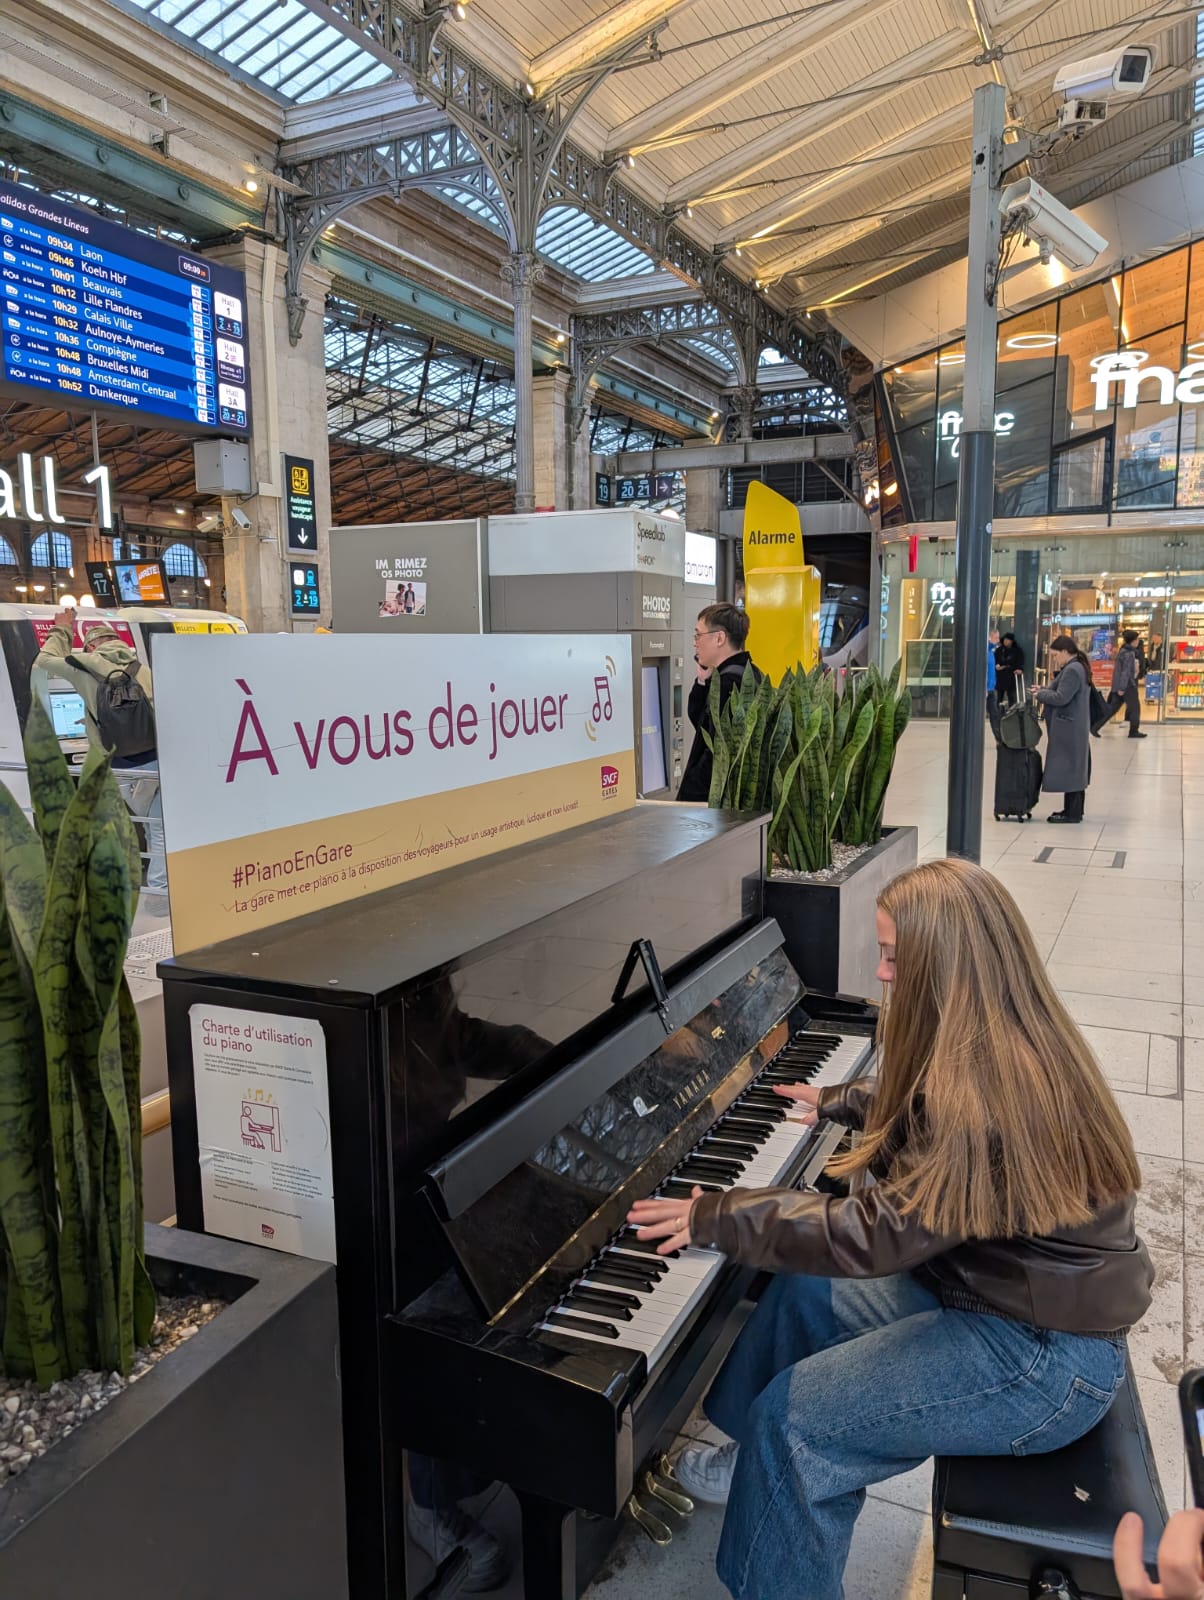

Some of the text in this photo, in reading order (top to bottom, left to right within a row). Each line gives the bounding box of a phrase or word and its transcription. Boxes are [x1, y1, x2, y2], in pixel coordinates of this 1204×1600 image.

[28, 204, 62, 224] Grandes
[47, 235, 74, 252] 09h34
[80, 245, 104, 263] Laon
[48, 251, 75, 268] 09h46
[81, 261, 108, 280] Koeln
[110, 271, 128, 286] Hbf
[50, 267, 75, 283] 10h01
[82, 276, 122, 299] Beauvais
[51, 283, 77, 300] 10h12
[83, 292, 103, 308] Lille
[105, 298, 143, 320] Flandres
[52, 300, 78, 315] 10h29
[84, 307, 112, 325] Calais
[113, 316, 133, 331] Ville
[53, 315, 79, 331] 10h32
[85, 323, 165, 355] Aulnoye-Aymeries
[54, 331, 80, 346] 10h36
[86, 338, 137, 362] Compiègne
[224, 343, 237, 353] Hall
[55, 347, 81, 362] 10h48
[87, 353, 129, 374] Bruxelles
[130, 365, 149, 379] Midi
[225, 352, 229, 360] 2
[56, 363, 82, 377] 10h48
[88, 369, 140, 391] Amsterdam
[141, 382, 177, 400] Centraal
[57, 379, 83, 392] 10h52
[89, 384, 139, 405] Dunkerque
[228, 397, 238, 407] 3A
[84, 465, 112, 529] 1
[599, 484, 609, 499] 19
[621, 485, 650, 497] 20 21
[749, 530, 796, 545] Alarme
[93, 580, 108, 594] 17
[394, 569, 423, 578] PHOTO
[309, 595, 319, 606] 19
[643, 595, 671, 612] PHOTOS
[225, 678, 569, 784] À vous de jouer
[602, 772, 618, 787] SNCF
[232, 844, 353, 889] #PianoEnGare
[235, 900, 248, 913] La
[251, 892, 275, 912] gare
[277, 886, 297, 901] met
[299, 883, 311, 894] ce
[313, 873, 339, 893] piano
[341, 868, 347, 881] à
[349, 866, 357, 879] la
[359, 855, 402, 876] disposition
[403, 849, 417, 862] des
[418, 839, 454, 858] voyageurs
[454, 832, 471, 848] pour
[471, 832, 479, 841] un
[480, 826, 498, 840] usage
[526, 811, 546, 824] ludique
[547, 809, 552, 818] et
[552, 807, 562, 816] non
[563, 800, 579, 813] lucratif
[201, 1018, 313, 1048] Charte d'utilisation
[203, 1034, 253, 1053] du piano
[672, 1069, 711, 1110] YAMAHA
